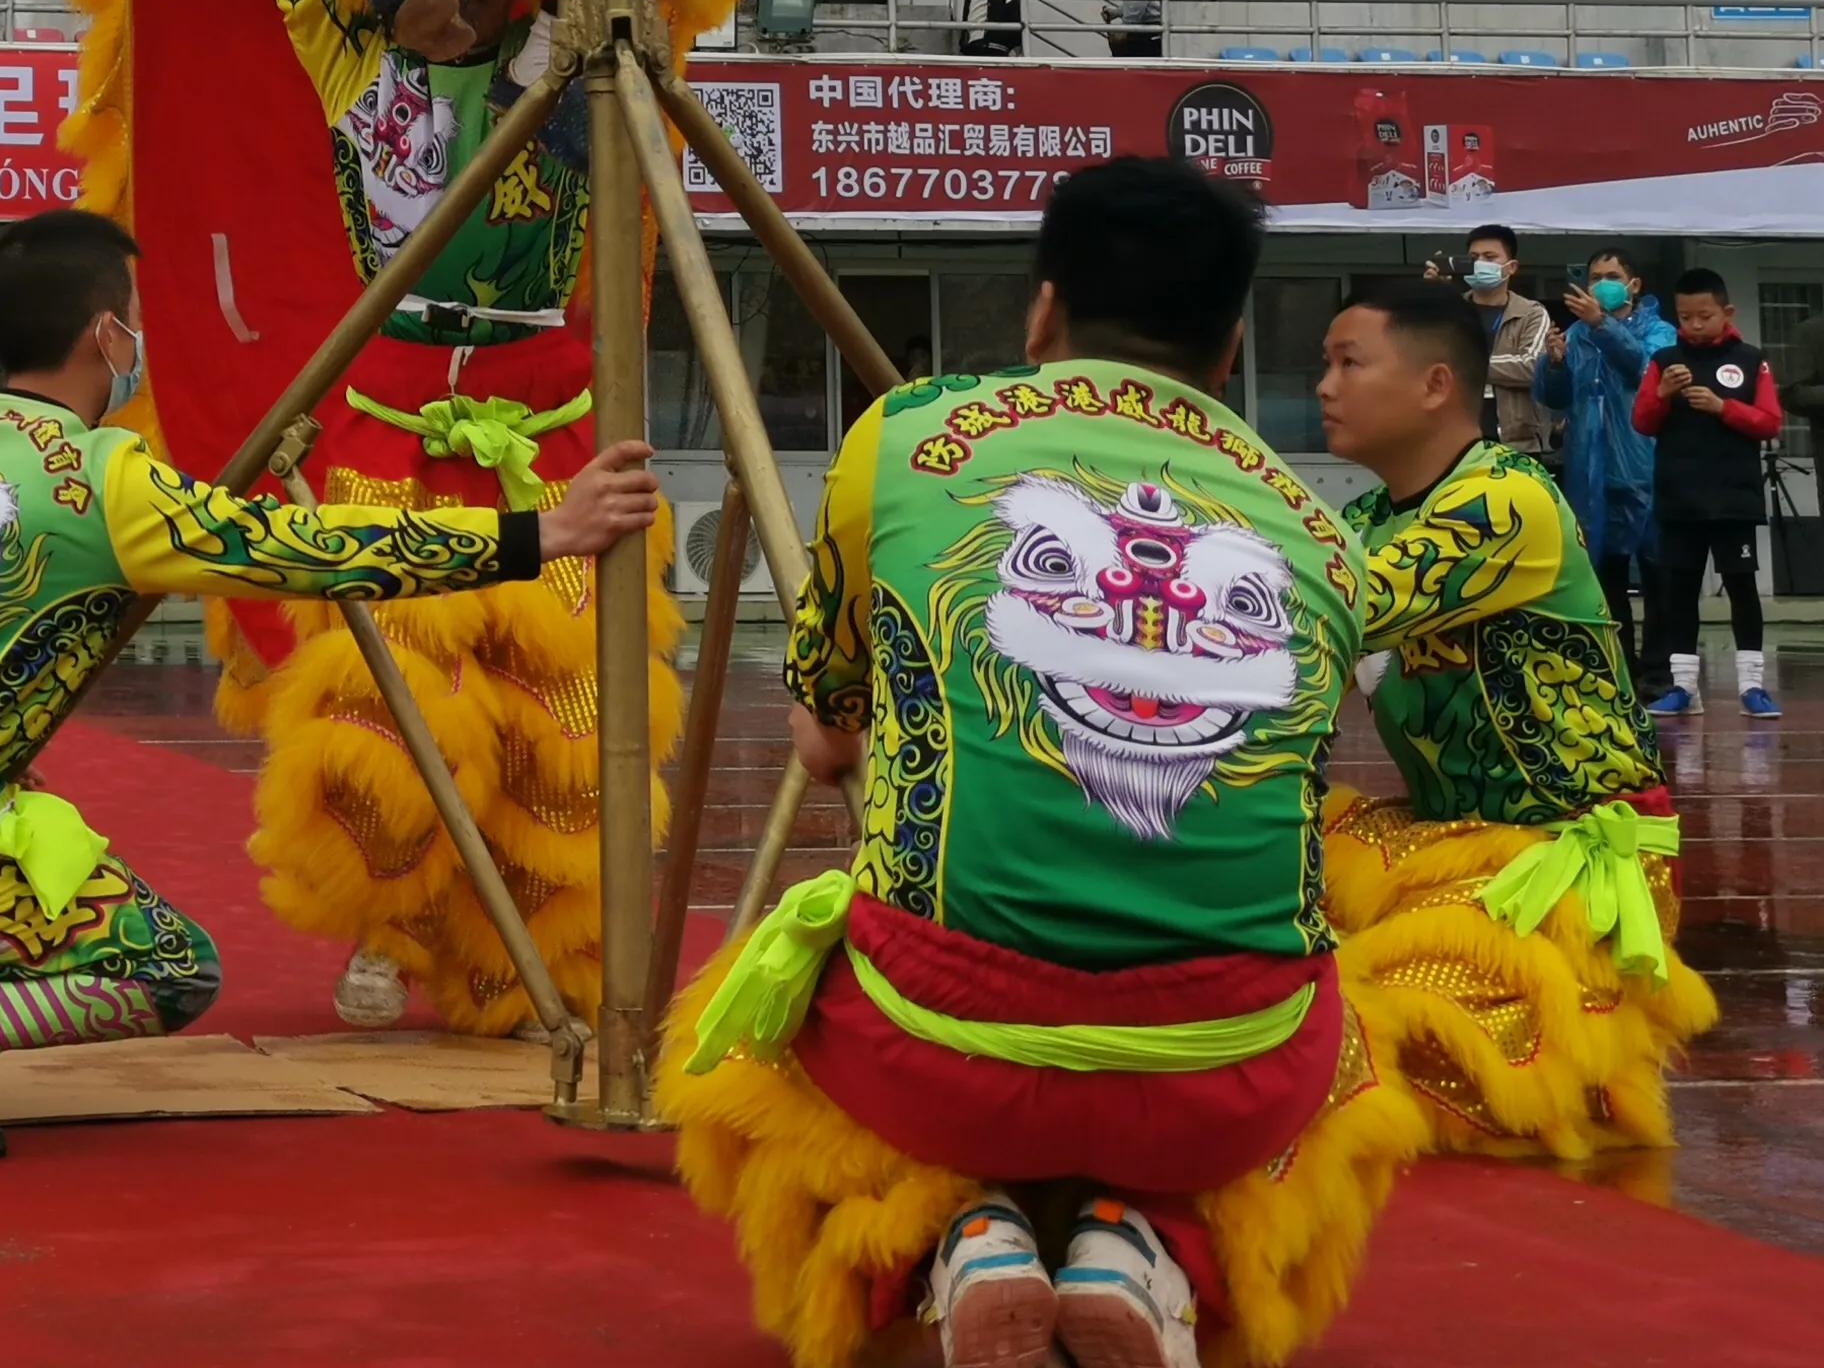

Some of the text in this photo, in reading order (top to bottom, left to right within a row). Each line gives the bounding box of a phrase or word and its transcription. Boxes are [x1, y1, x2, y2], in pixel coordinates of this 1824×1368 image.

[1183, 107, 1254, 132] PHIN
[1687, 114, 1764, 142] AUHENTIC
[810, 120, 1112, 159] 东兴市越品汇贸易有限公司
[1184, 134, 1254, 157] DELI
[1224, 162, 1263, 175] COFFEE
